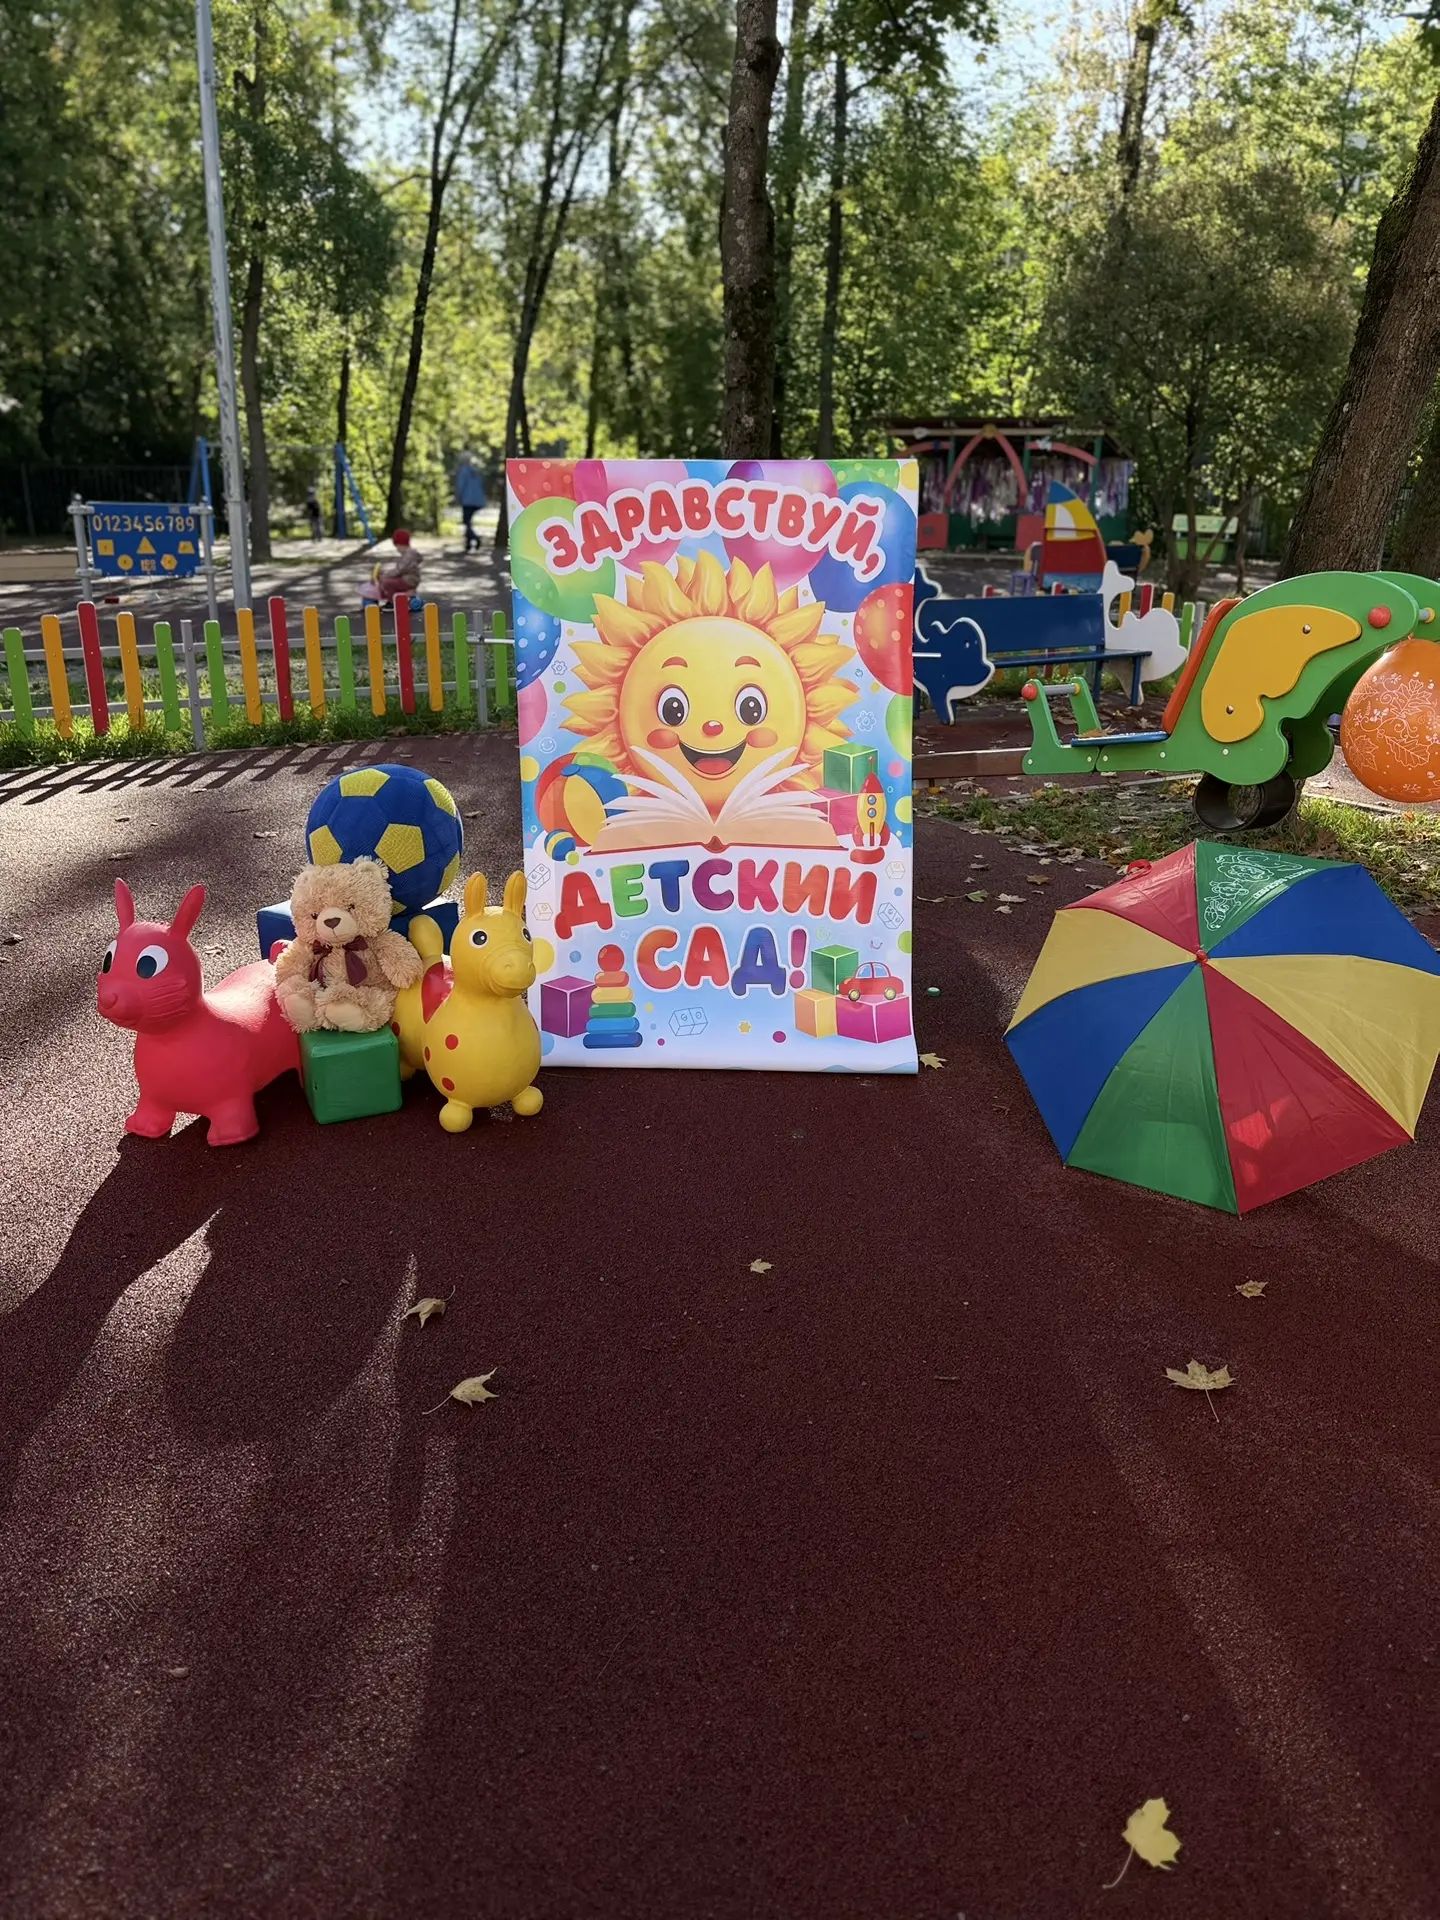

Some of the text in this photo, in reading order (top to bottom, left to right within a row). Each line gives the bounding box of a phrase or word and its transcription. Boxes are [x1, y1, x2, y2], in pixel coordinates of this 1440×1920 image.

[93, 515, 195, 532] 0123456789
[543, 486, 881, 576] ЗДРАВСТВУЙ,
[635, 925, 808, 997] САД!
